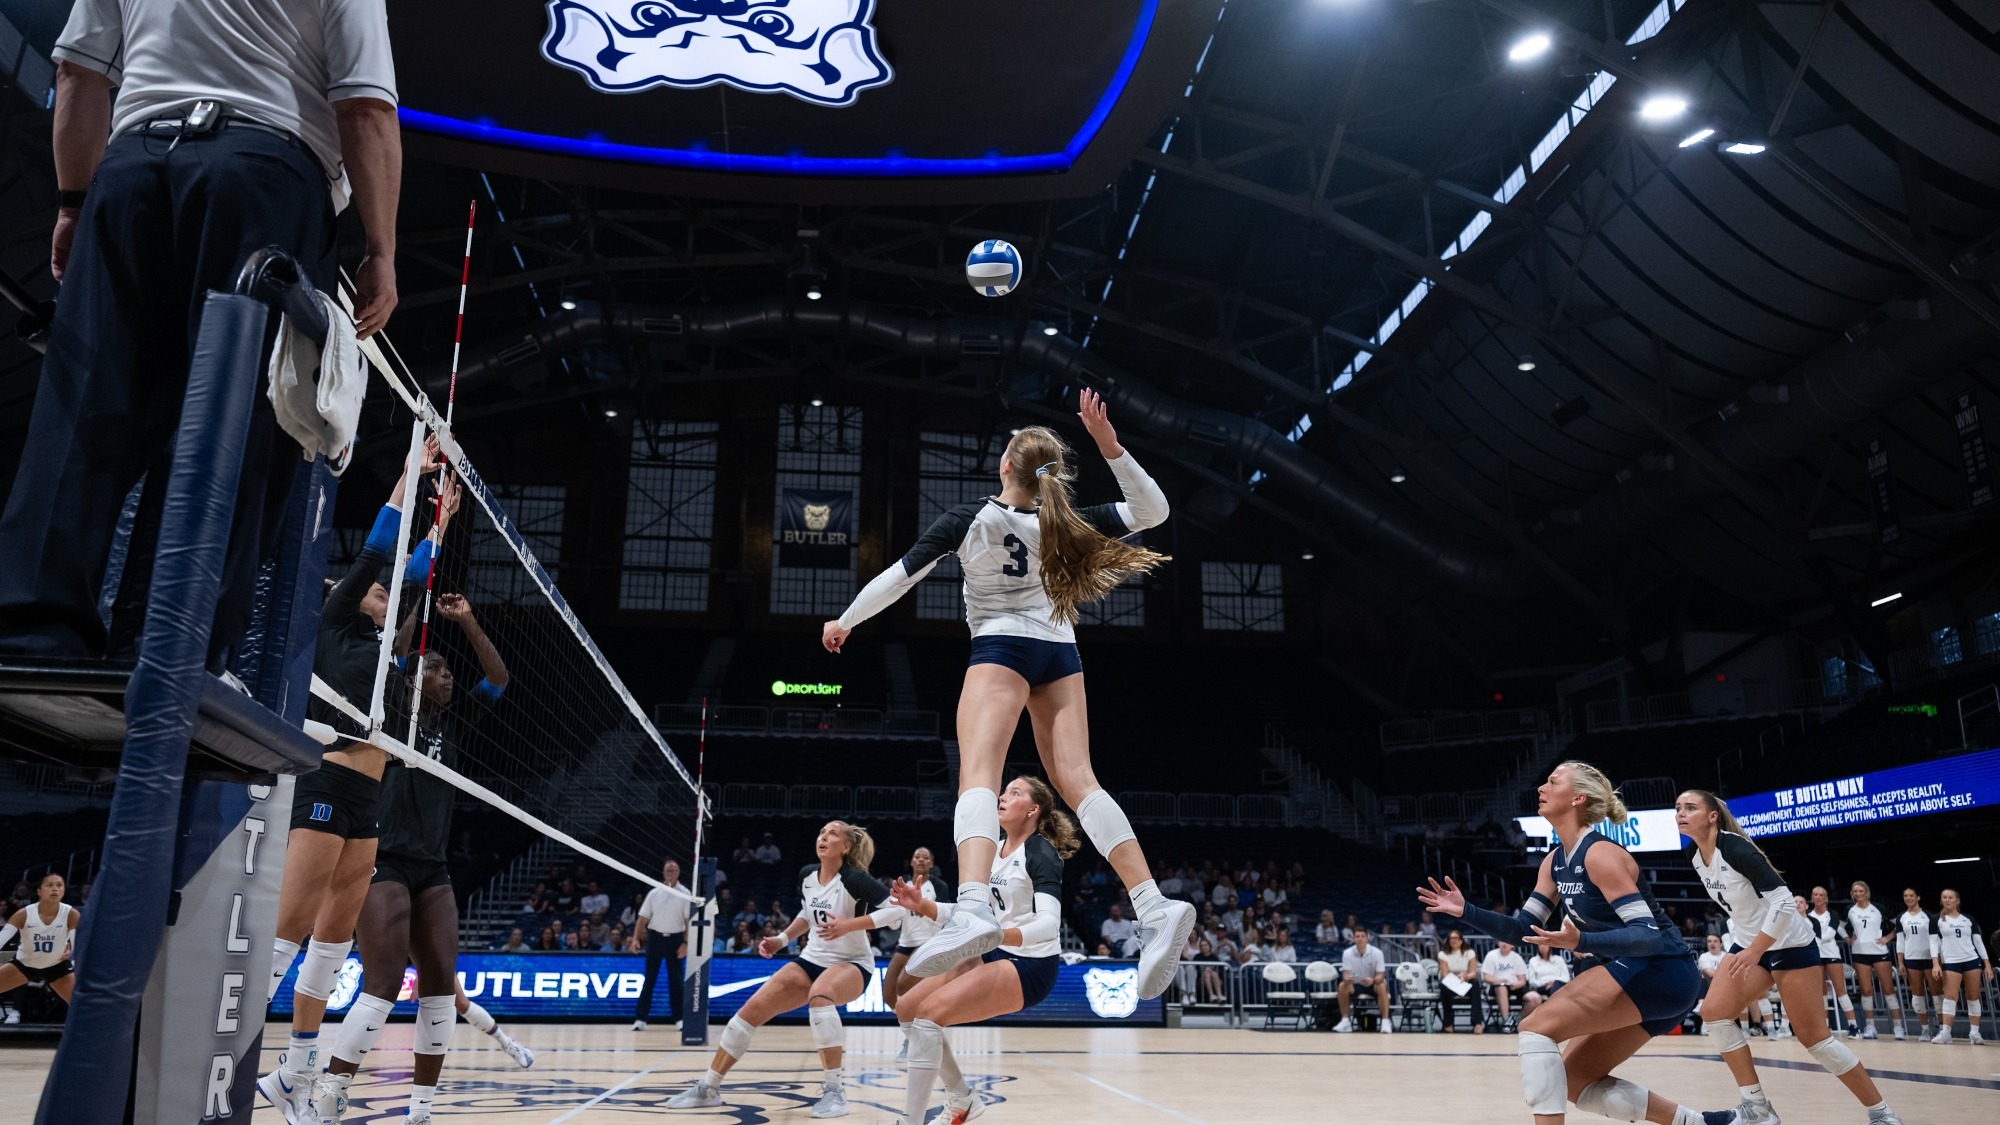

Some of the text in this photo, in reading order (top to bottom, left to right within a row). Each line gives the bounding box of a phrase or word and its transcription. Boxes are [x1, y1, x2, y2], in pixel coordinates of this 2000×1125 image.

[783, 530, 848, 545] BUTLER
[1003, 533, 1028, 577] 3
[786, 683, 842, 695] DROPLIGHT
[1775, 776, 1864, 808] THE BUTLER WAY
[1750, 808, 1796, 825] COMMITMENT,
[1795, 803, 1820, 818] DENIES
[1820, 795, 1871, 814] SELFISHNESS,
[1872, 789, 1907, 806] ACCEPTS
[1907, 783, 1946, 799] REALITY,
[1744, 793, 1976, 837] PROVEMENT EVERYDAY WHILE PUTTING THE TEAM ABOVE SELF.
[990, 874, 1008, 886] utler
[1705, 878, 1727, 890] Butler
[809, 897, 832, 909] Butler
[1717, 892, 1732, 912] 4
[1861, 919, 1867, 928] 7
[1911, 925, 1918, 935] 11
[1955, 928, 1961, 938] 9
[33, 933, 55, 941] Duke
[33, 941, 53, 953] 10
[203, 784, 273, 1120] TLER
[457, 971, 646, 999] UTLERVB
